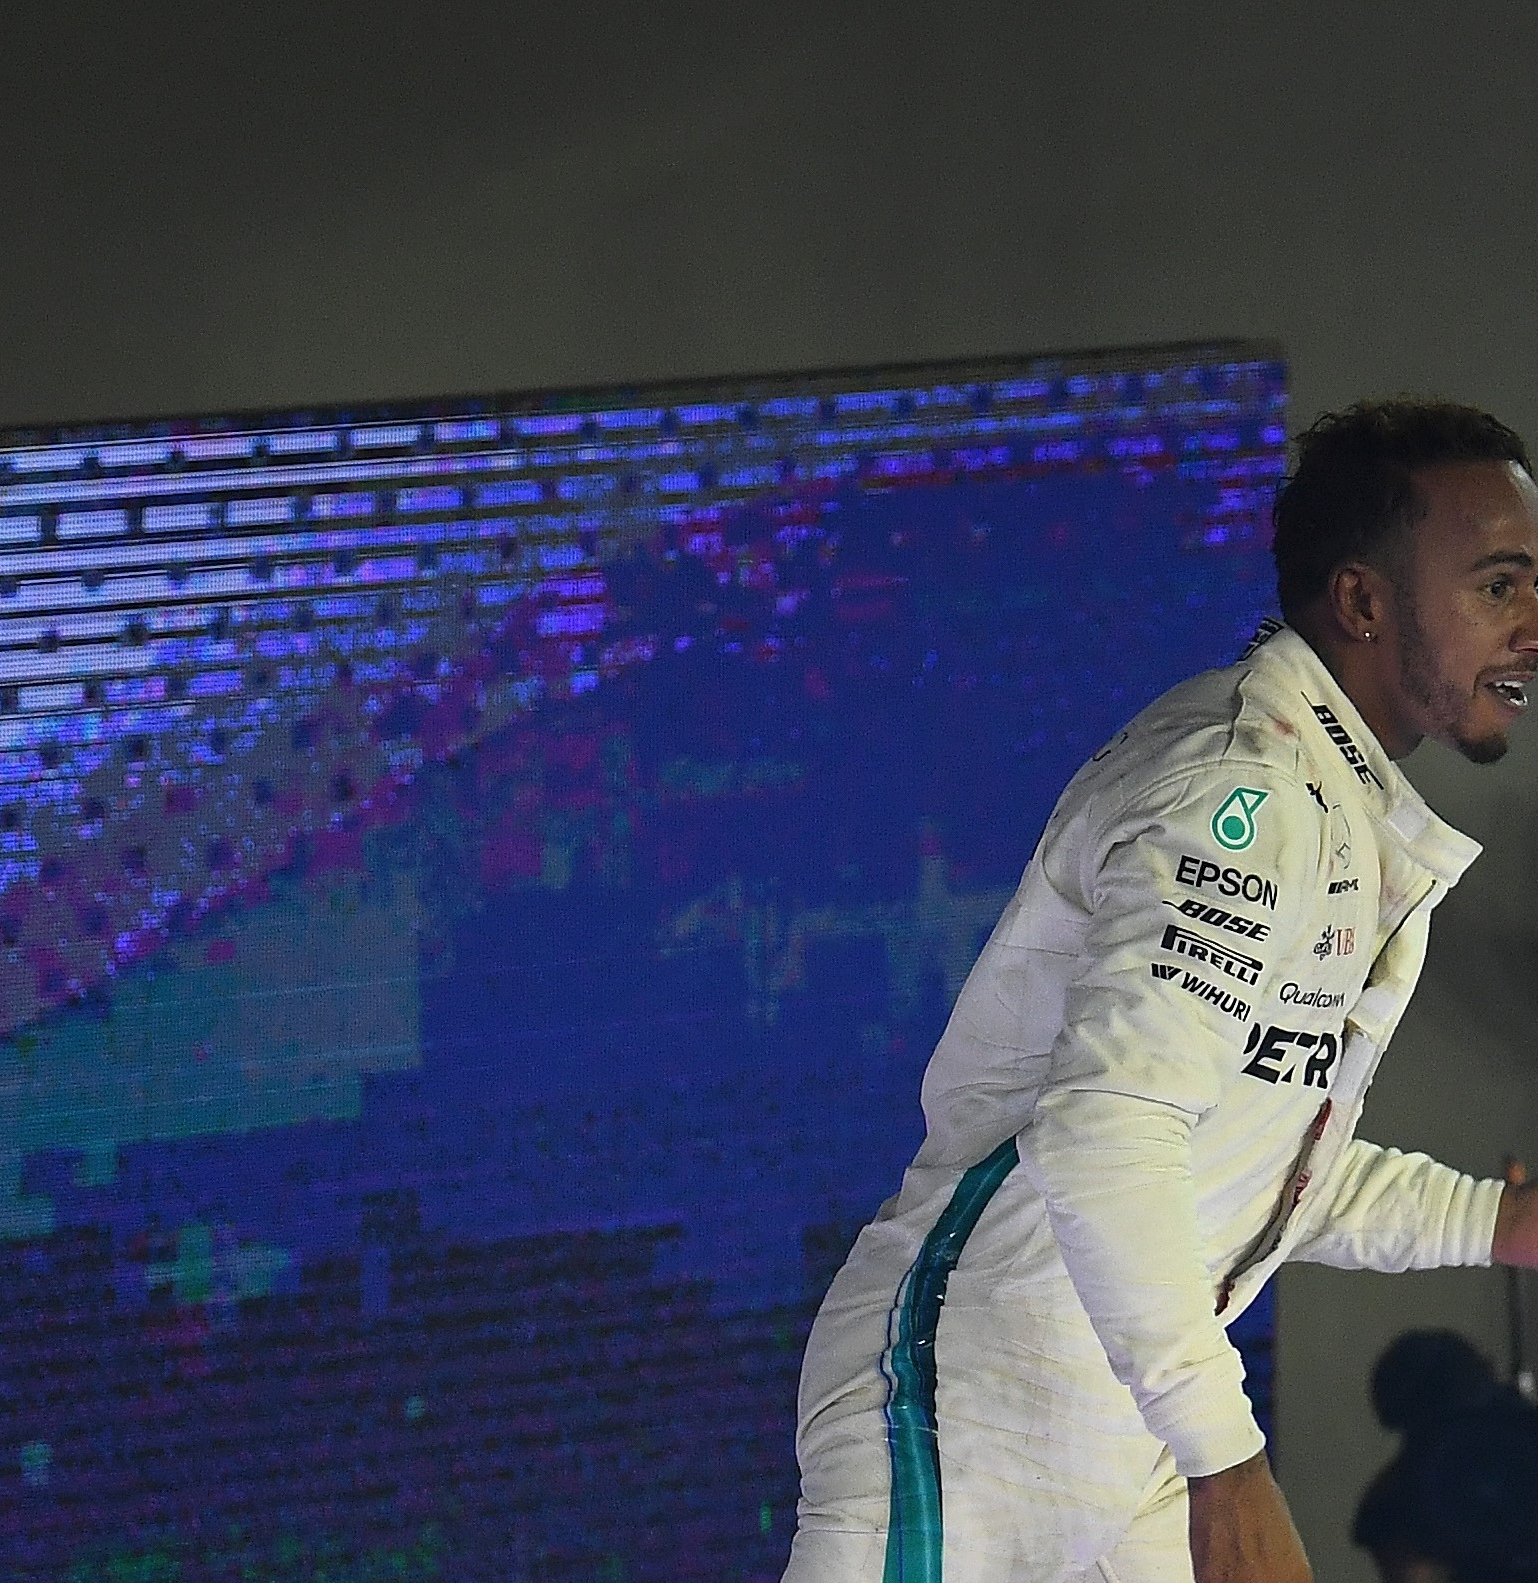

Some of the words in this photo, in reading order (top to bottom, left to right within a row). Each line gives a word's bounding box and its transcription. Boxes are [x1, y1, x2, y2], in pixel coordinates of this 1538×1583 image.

[1301, 691, 1384, 790] BOSE
[1176, 855, 1278, 911] EPSON
[1163, 899, 1272, 942] BOSE
[1161, 925, 1264, 986] PIRELLI
[1181, 971, 1252, 1022] WIHURI
